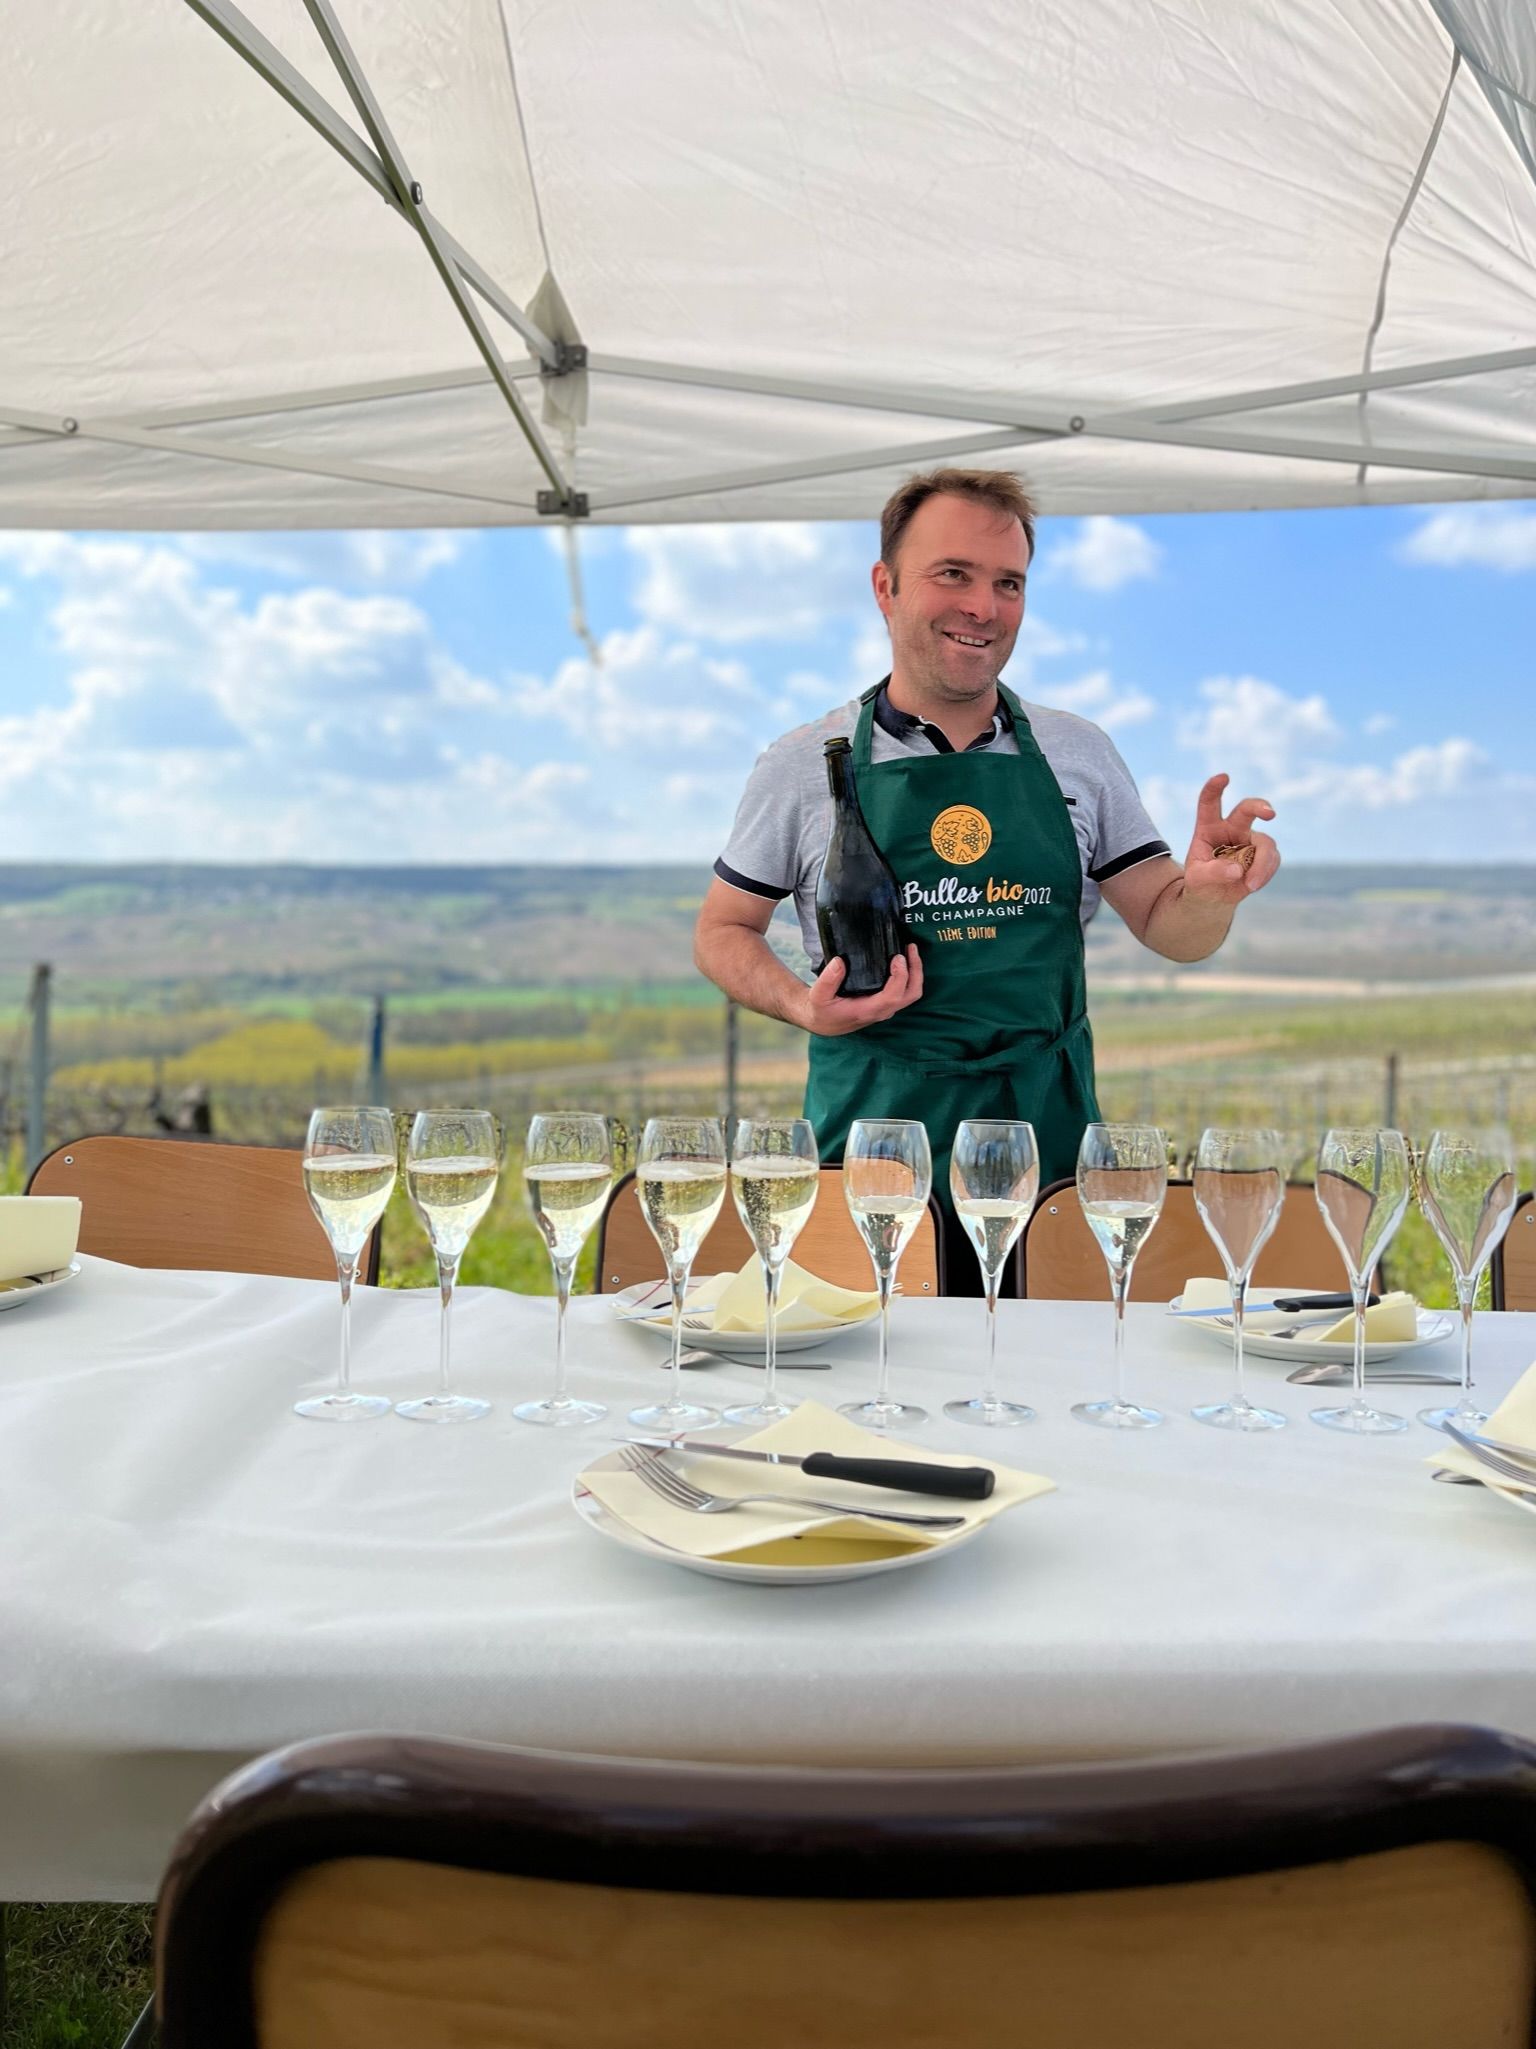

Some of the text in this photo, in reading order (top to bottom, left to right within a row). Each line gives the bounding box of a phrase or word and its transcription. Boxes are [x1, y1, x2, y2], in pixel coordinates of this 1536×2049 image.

[902, 876, 1052, 909] Bulles bio 2022
[904, 905, 1025, 923] EN CHAMPAGNE
